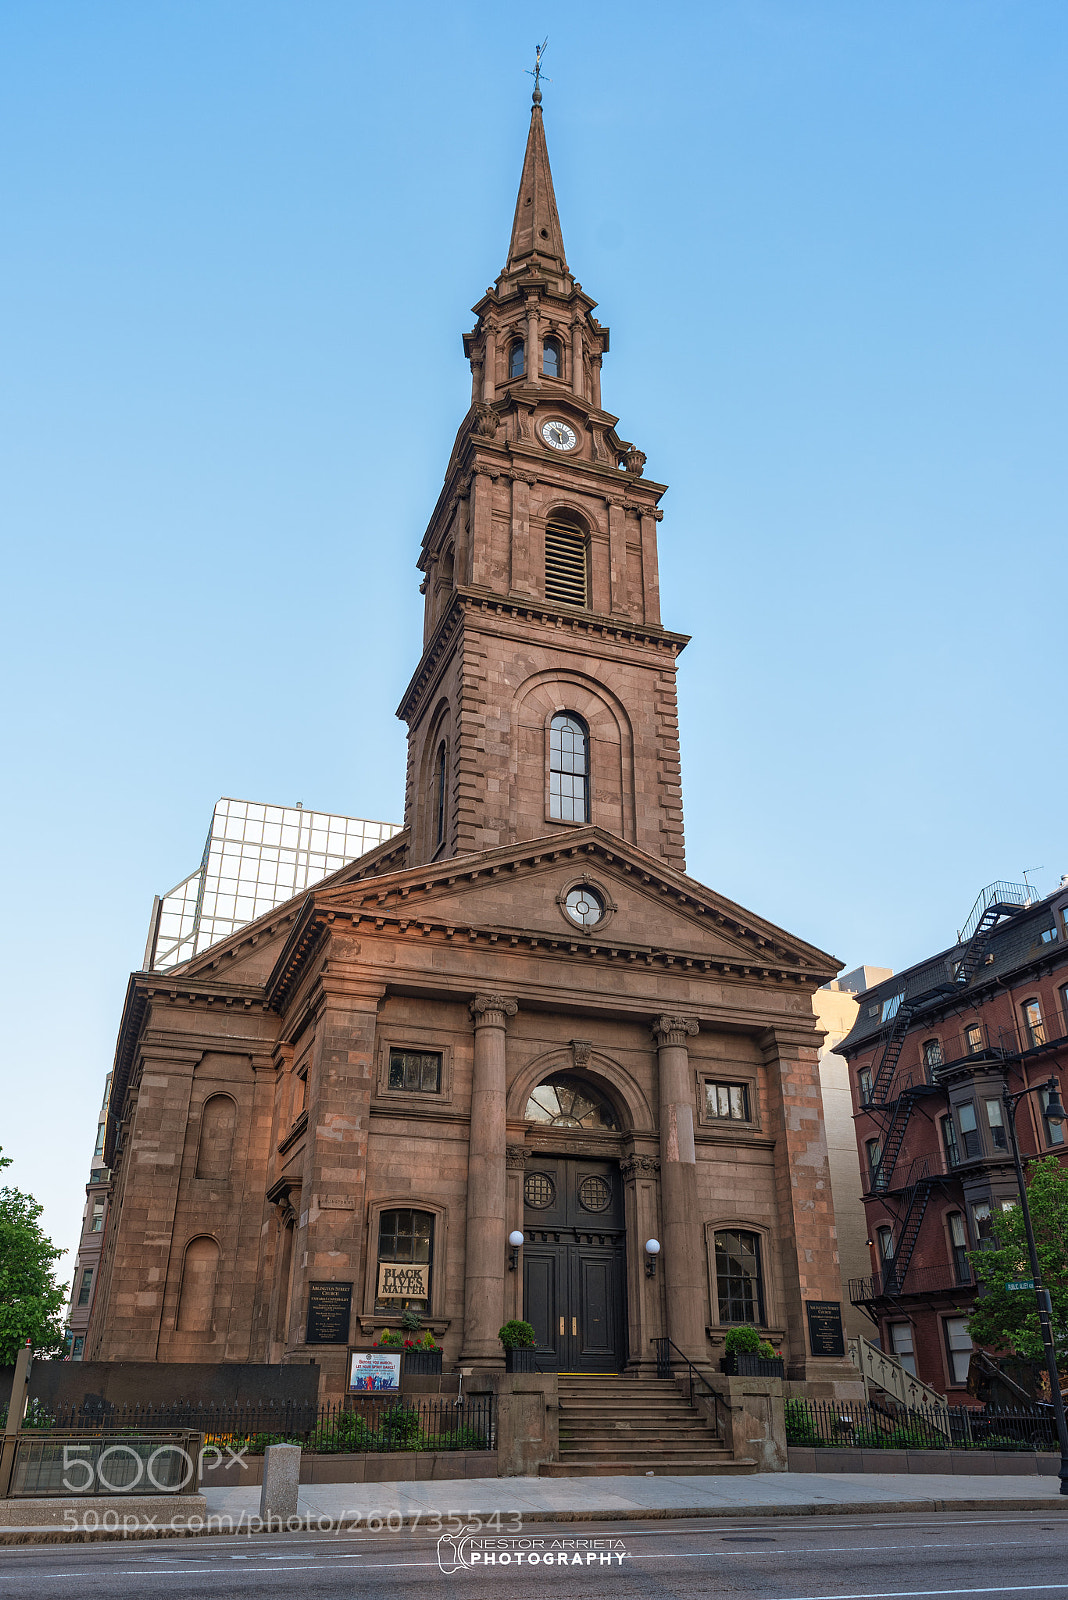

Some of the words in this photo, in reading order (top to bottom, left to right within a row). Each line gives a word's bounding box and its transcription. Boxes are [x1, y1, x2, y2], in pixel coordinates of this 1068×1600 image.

[384, 1268, 422, 1278] BLACK
[384, 1276, 422, 1287] LIVES
[382, 1284, 426, 1294] MATTER
